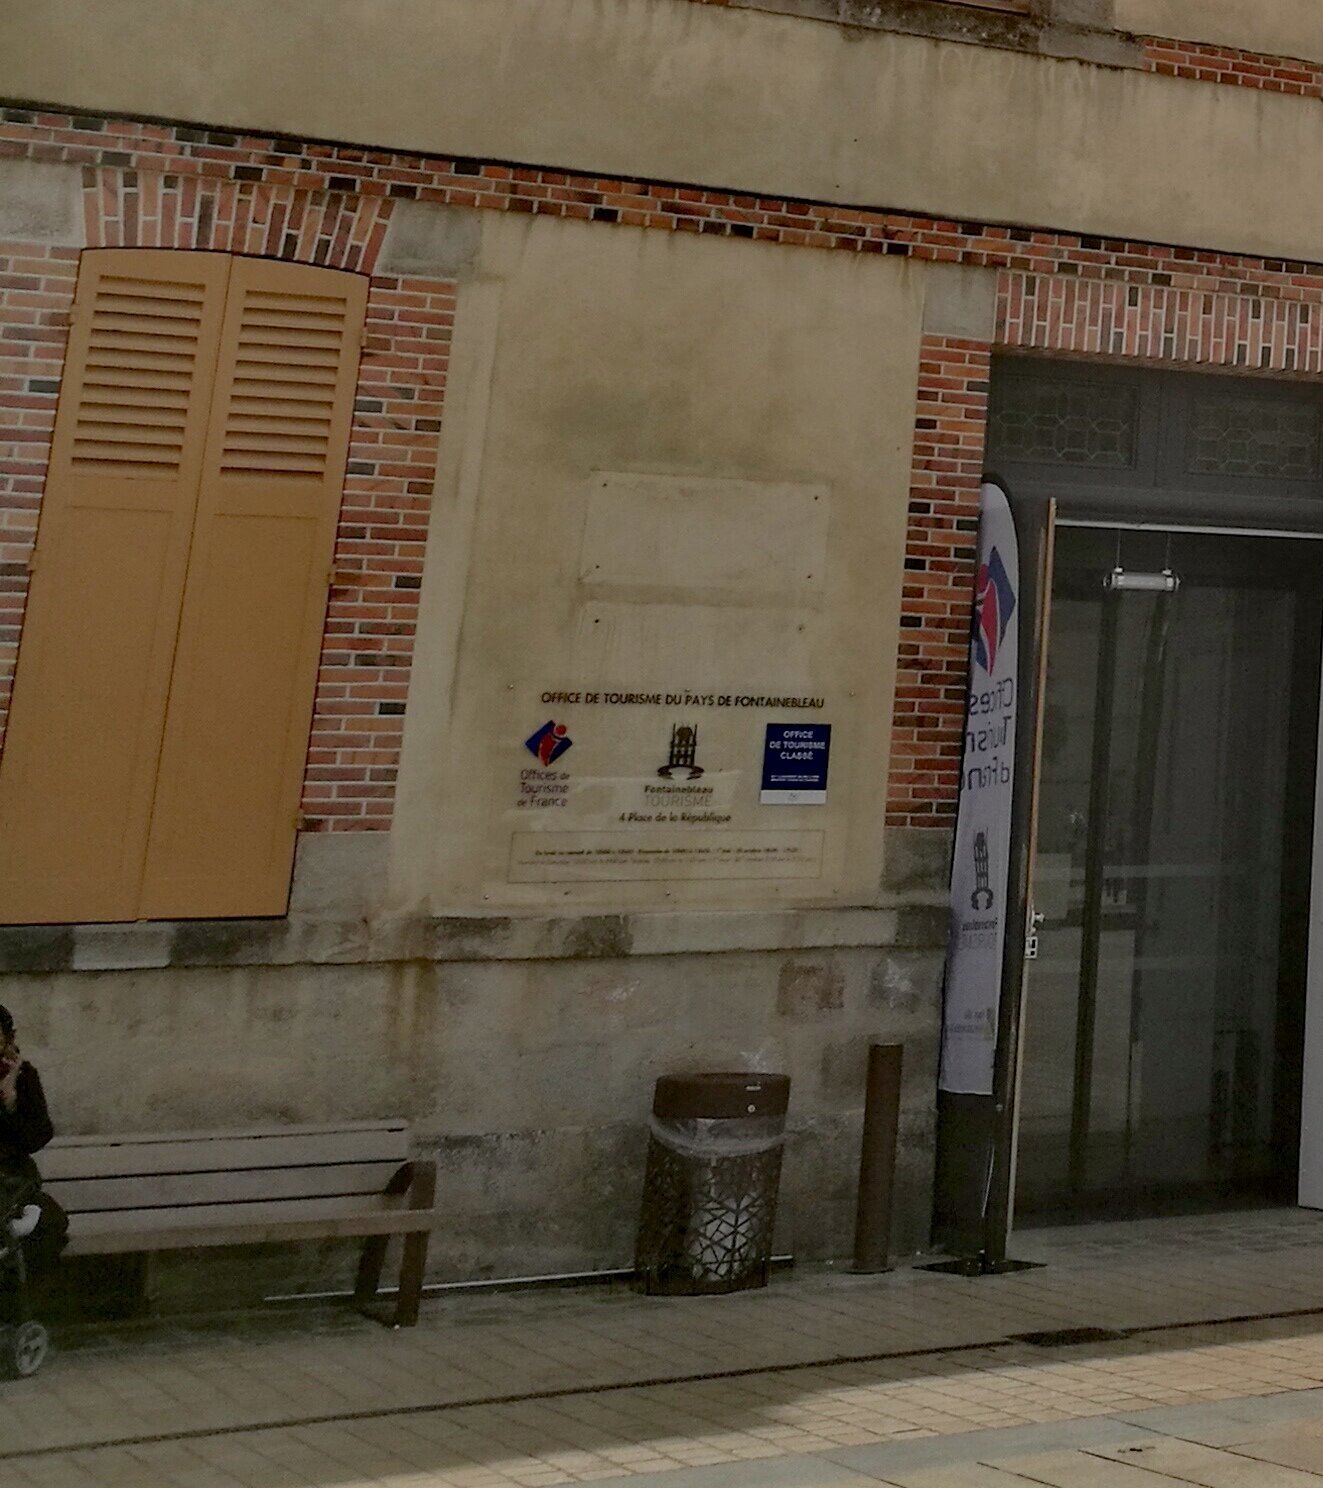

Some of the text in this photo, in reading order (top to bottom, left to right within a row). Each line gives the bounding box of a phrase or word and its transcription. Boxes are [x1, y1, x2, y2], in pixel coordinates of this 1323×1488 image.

[541, 691, 825, 709] OFFICE DE TOURISME DU PAYS DE FONTAINEBLEAU
[783, 730, 814, 739] OFFICE
[769, 741, 826, 750] DE TOURISME
[520, 768, 557, 781] Offices
[520, 781, 569, 794] Tourisme
[644, 784, 714, 794] Fontainebleau
[530, 794, 568, 807] France
[645, 794, 713, 808] TOURISME
[627, 812, 653, 822] Place
[655, 812, 667, 822] de
